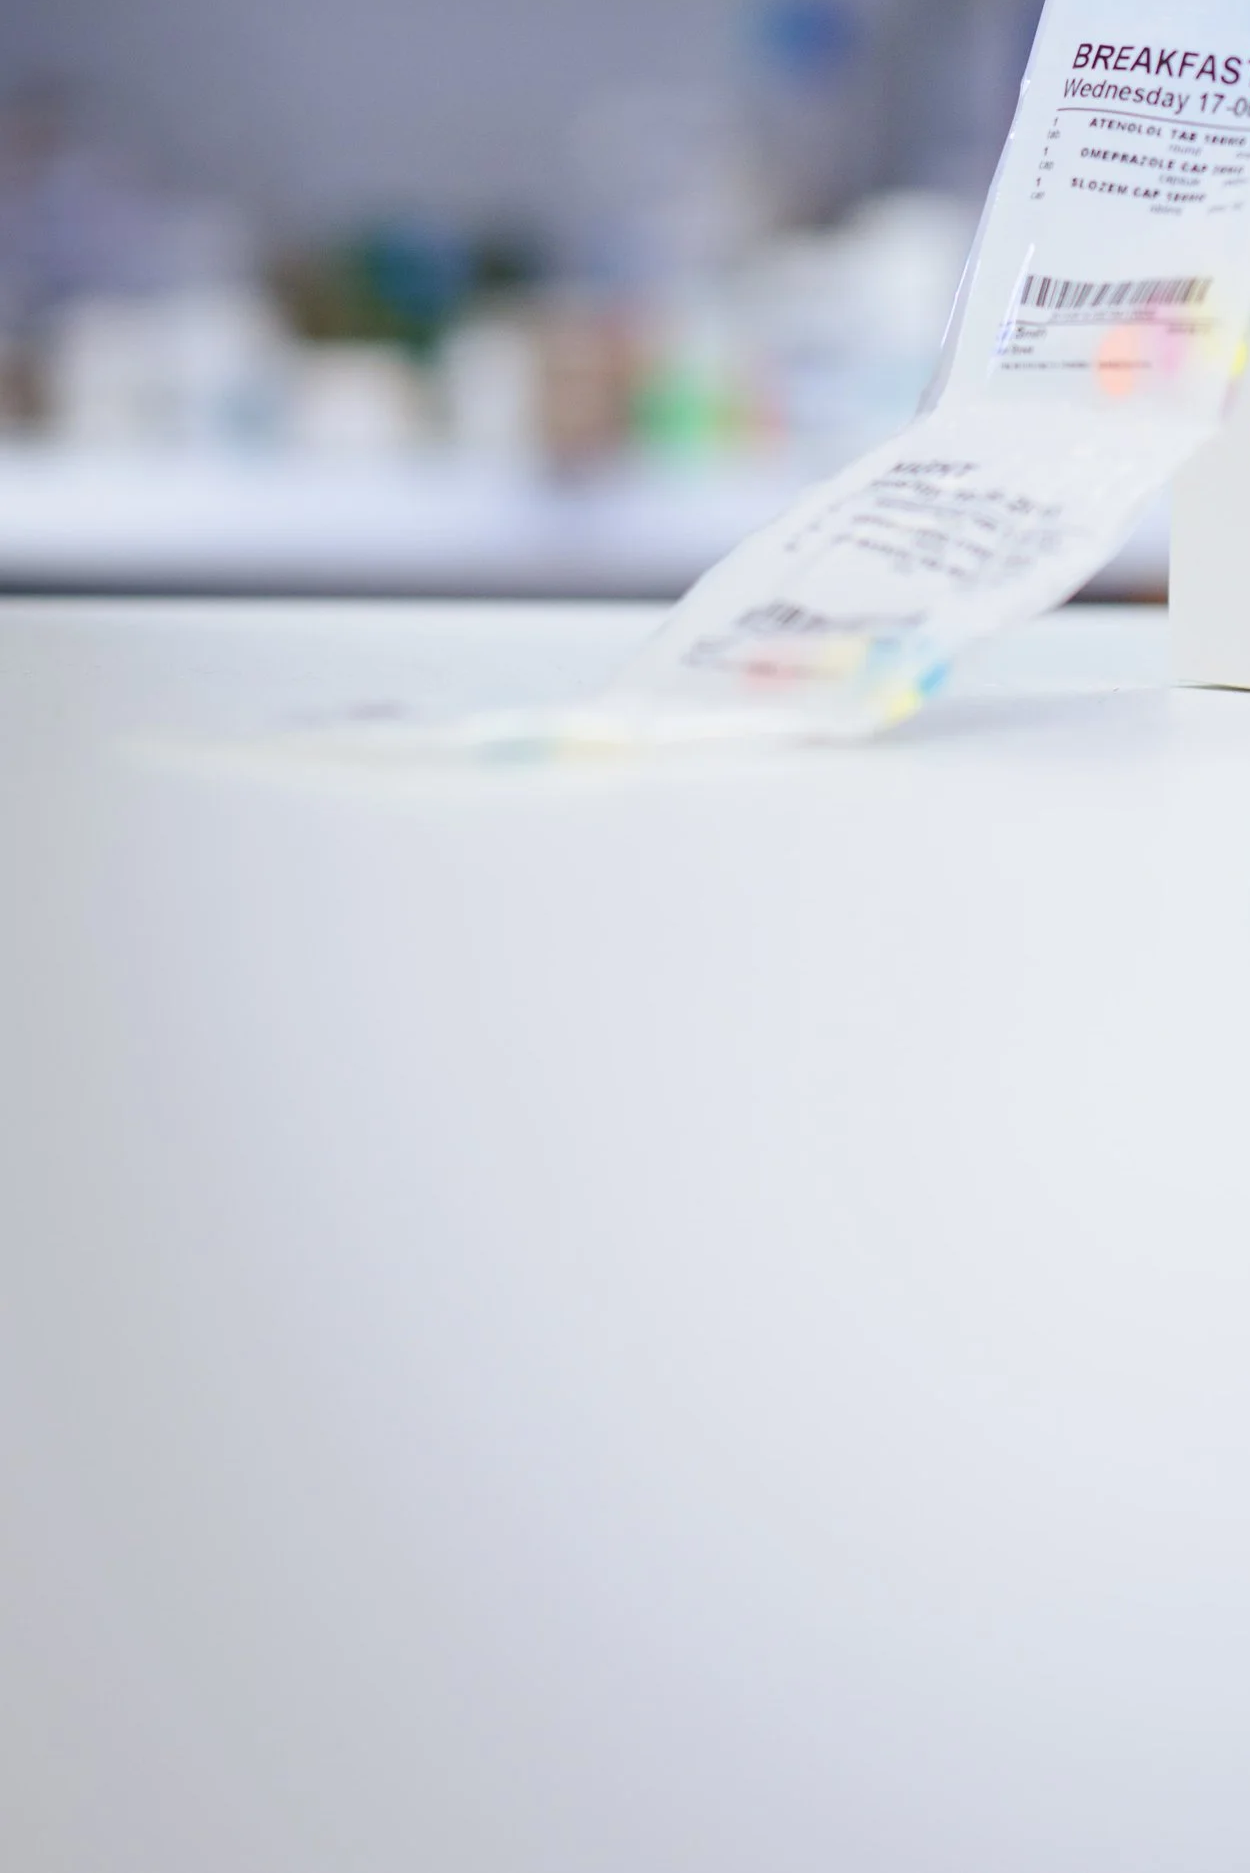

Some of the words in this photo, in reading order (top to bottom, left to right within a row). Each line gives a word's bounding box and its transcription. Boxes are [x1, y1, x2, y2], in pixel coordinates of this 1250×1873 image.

[1063, 78, 1190, 115] Wednesday
[1089, 117, 1163, 136] ATENOLOL
[1171, 128, 1198, 142] TAB
[1080, 147, 1175, 170] OMEPRAZOLE
[1180, 161, 1208, 173] CAP
[1071, 177, 1128, 195] SLOZEM
[1132, 186, 1161, 199] CAP
